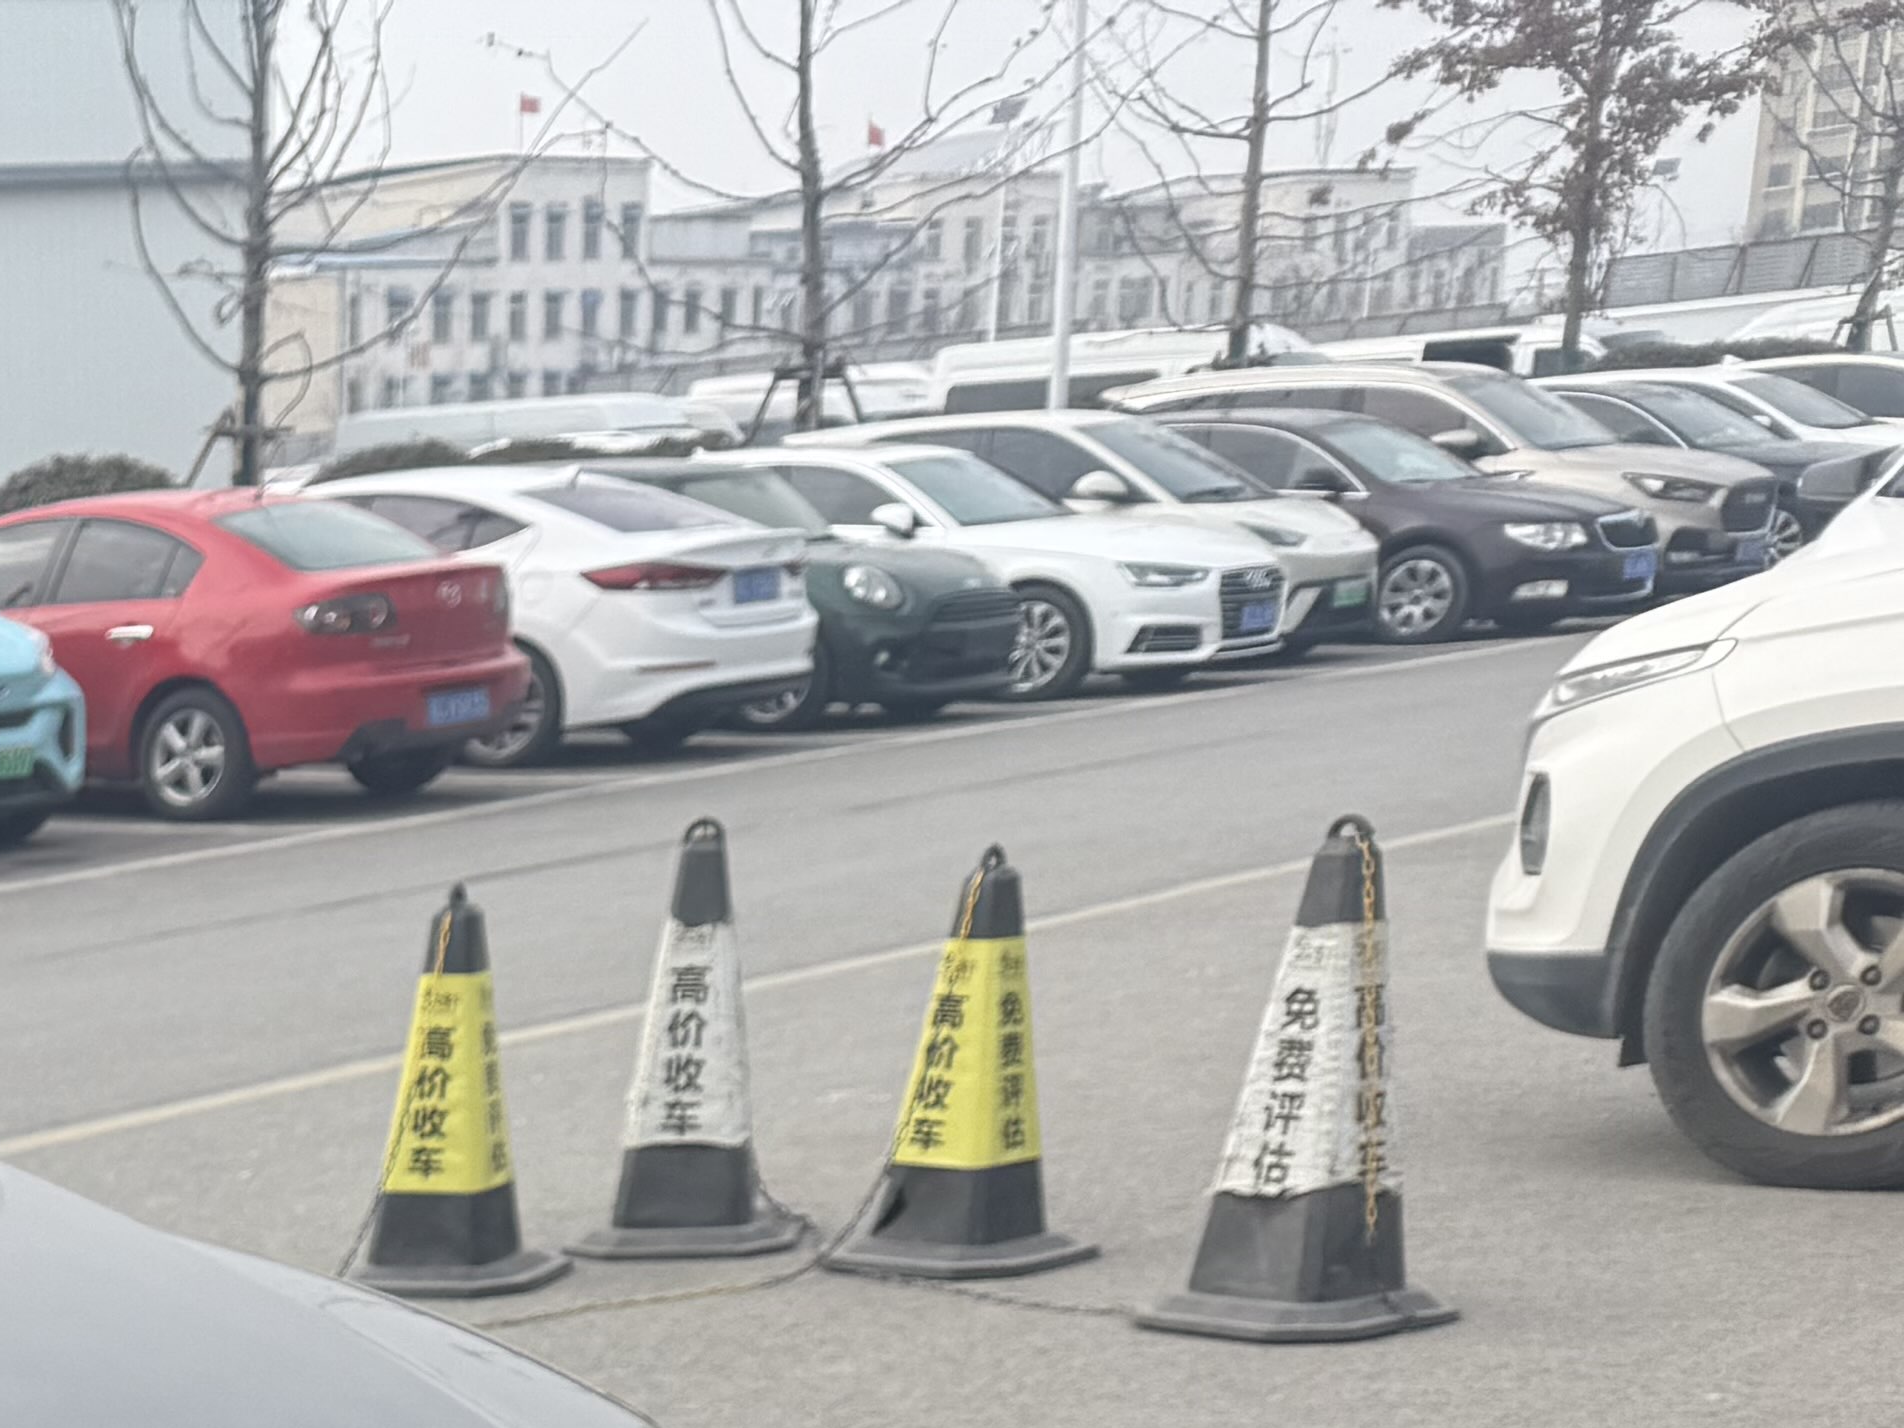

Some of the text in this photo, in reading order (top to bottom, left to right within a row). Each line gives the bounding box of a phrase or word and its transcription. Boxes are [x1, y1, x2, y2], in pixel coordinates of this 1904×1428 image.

[409, 1026, 456, 1179] 高价收车
[661, 965, 713, 1136] 高价收车
[909, 993, 969, 1151] 高价收车
[1253, 986, 1320, 1185] 免费评估
